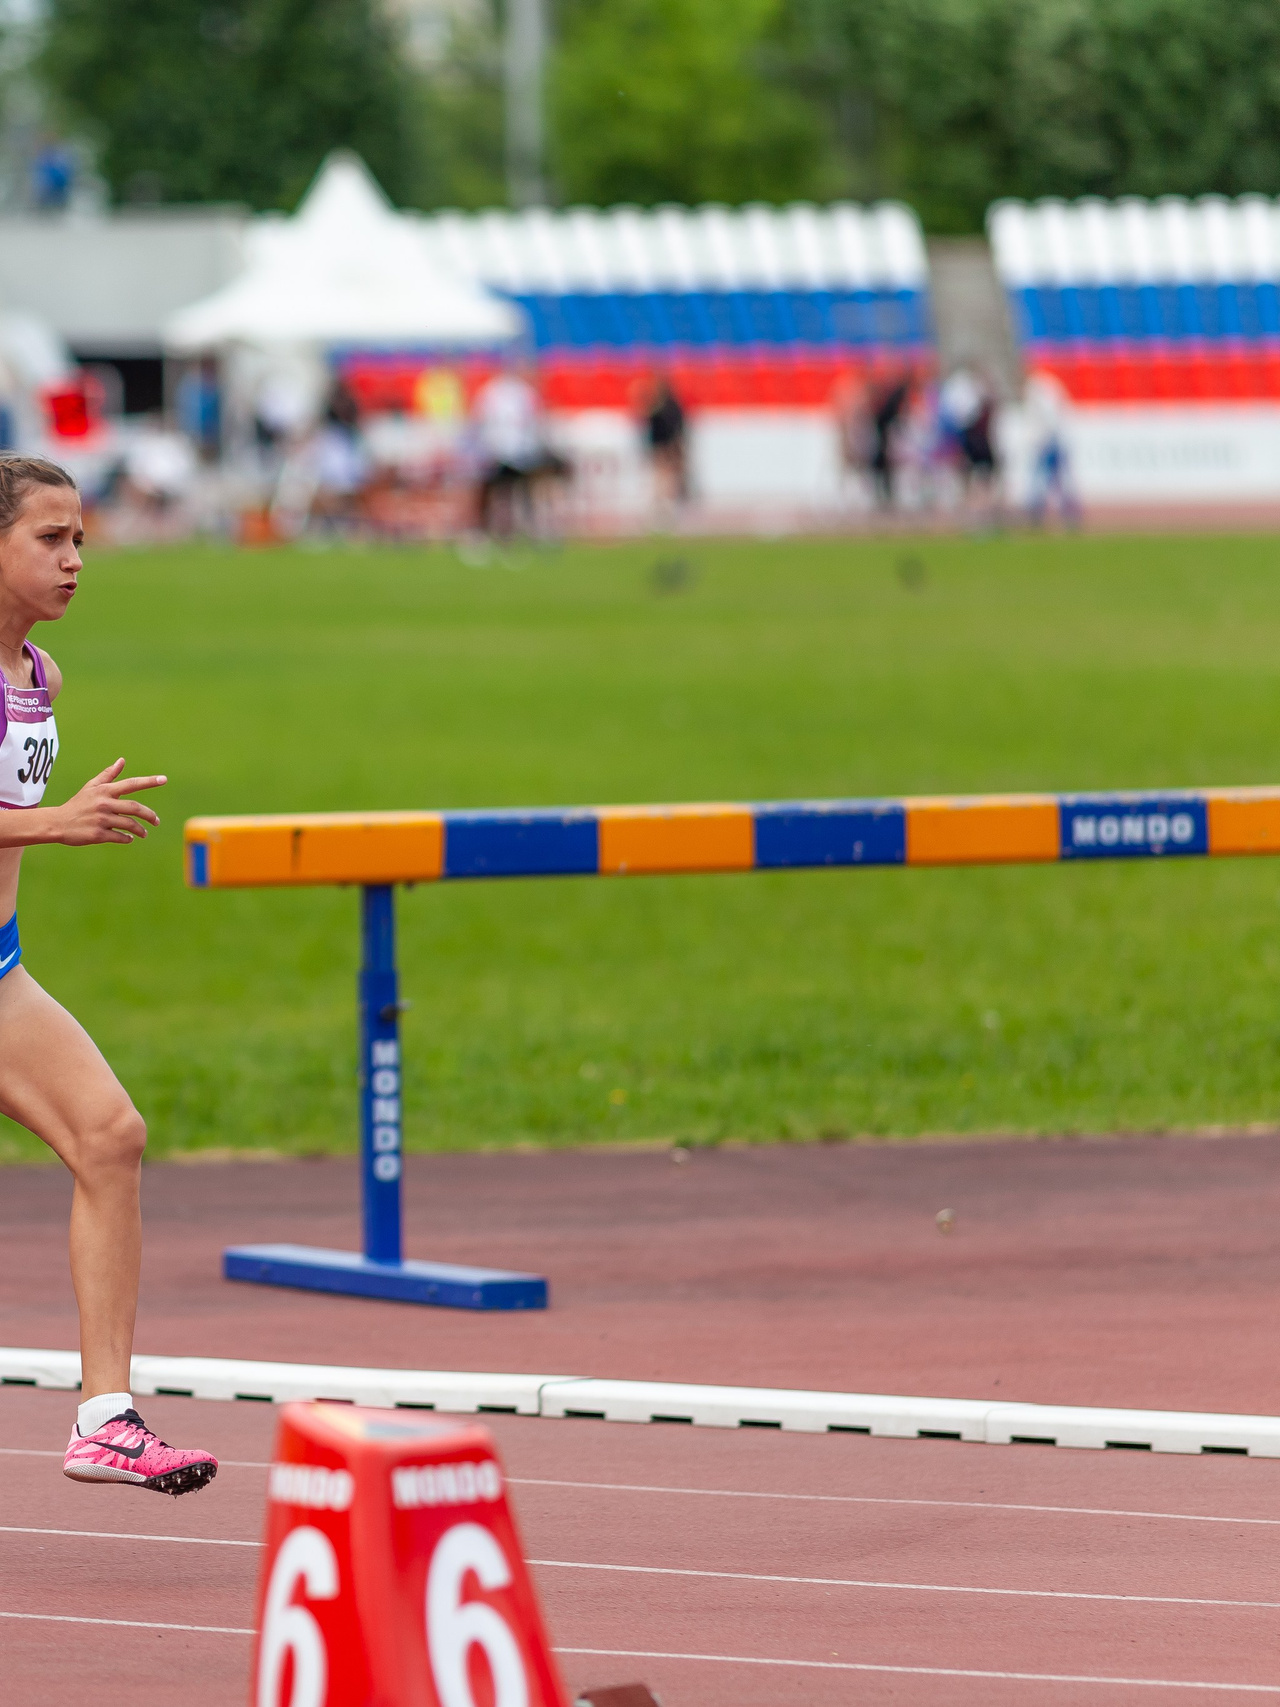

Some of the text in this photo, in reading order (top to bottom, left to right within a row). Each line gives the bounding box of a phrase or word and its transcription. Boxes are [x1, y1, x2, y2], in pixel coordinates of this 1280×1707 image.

[18, 736, 54, 785] 306
[1072, 812, 1195, 847] MONDO
[371, 1039, 401, 1182] MONDO
[392, 1459, 502, 1510] MONDO
[256, 1524, 340, 1707] 6
[424, 1520, 529, 1707] 6
